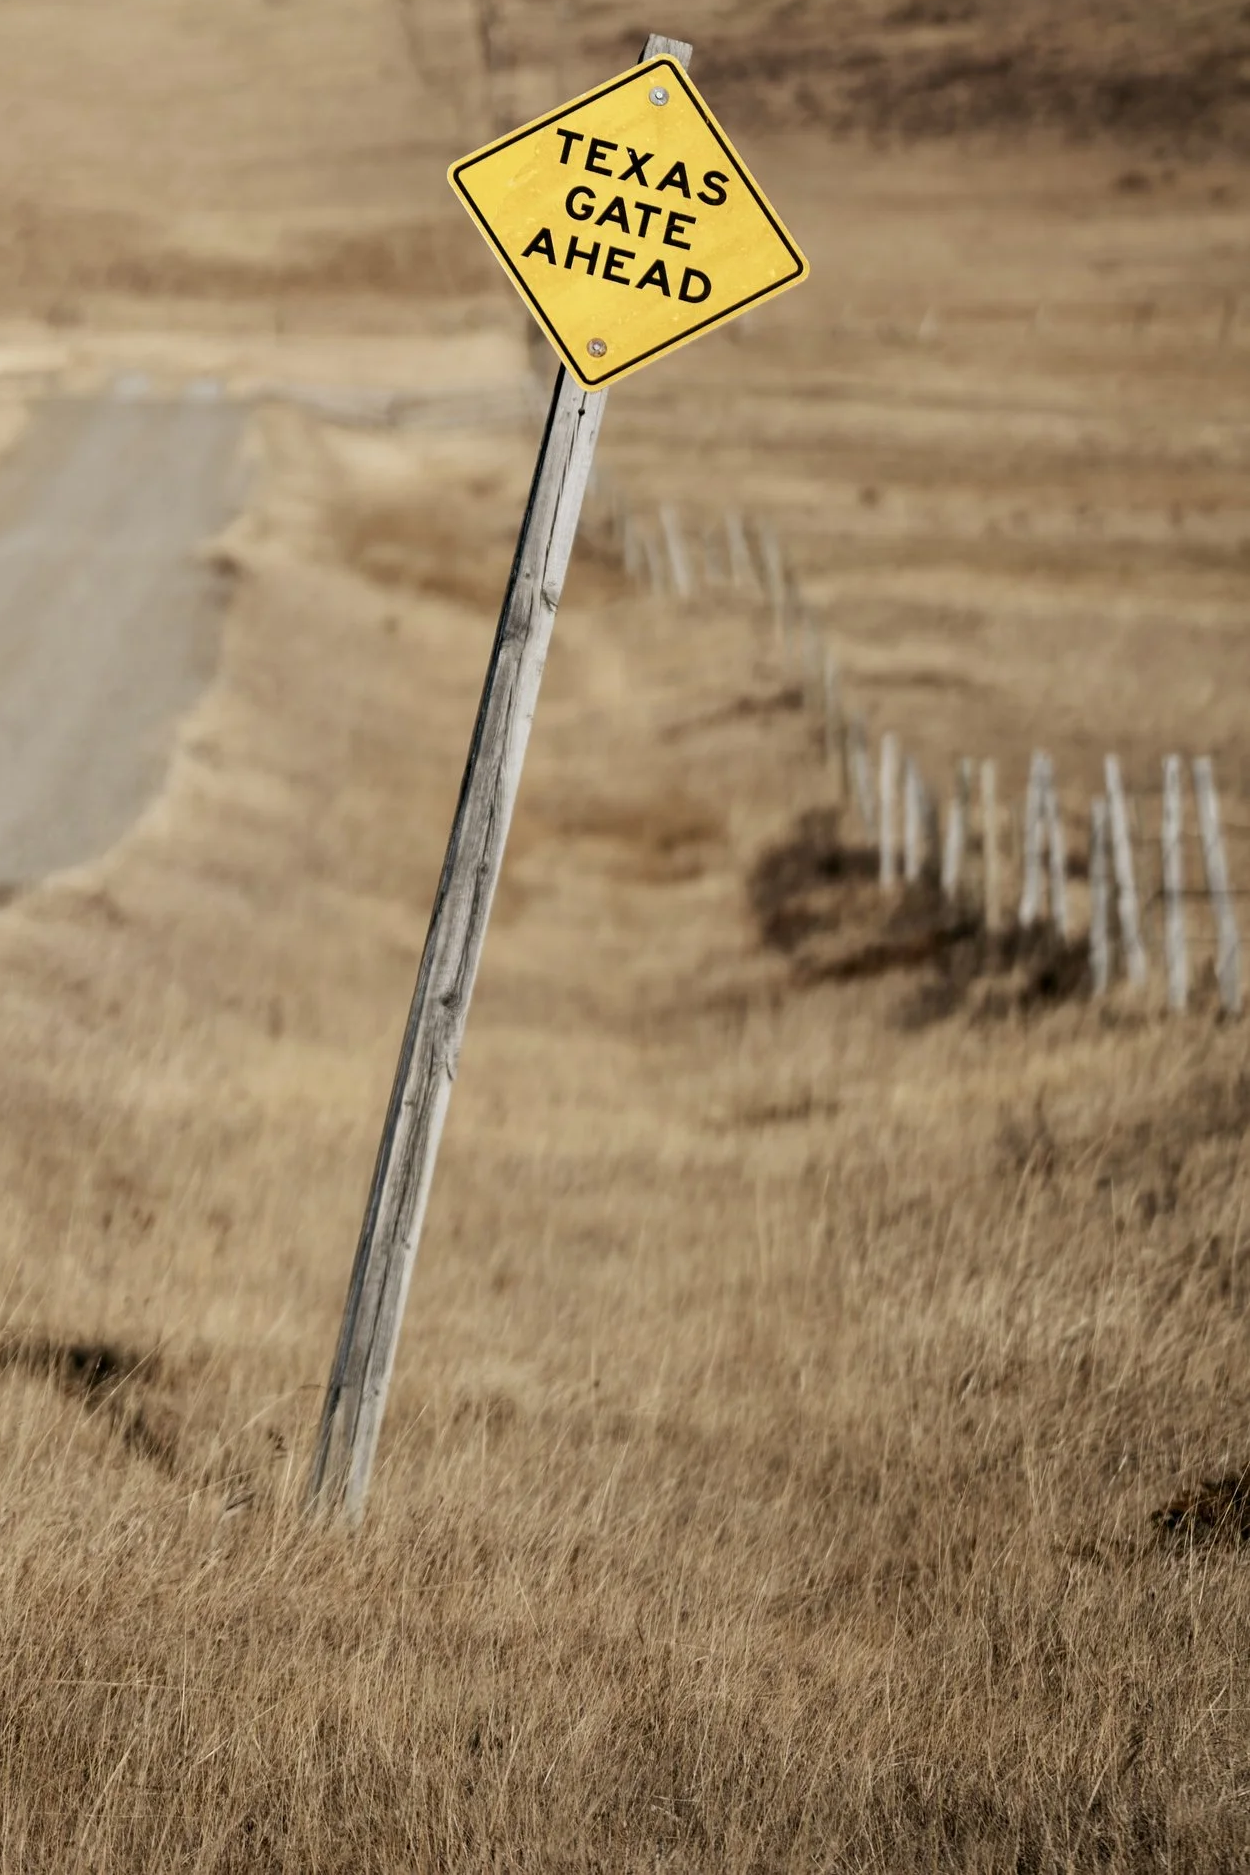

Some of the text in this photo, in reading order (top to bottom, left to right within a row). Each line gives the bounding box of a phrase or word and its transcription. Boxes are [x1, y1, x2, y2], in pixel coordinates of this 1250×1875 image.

[556, 128, 730, 206] TEXAS
[565, 185, 697, 251] GATE
[521, 227, 712, 304] AHEAD
